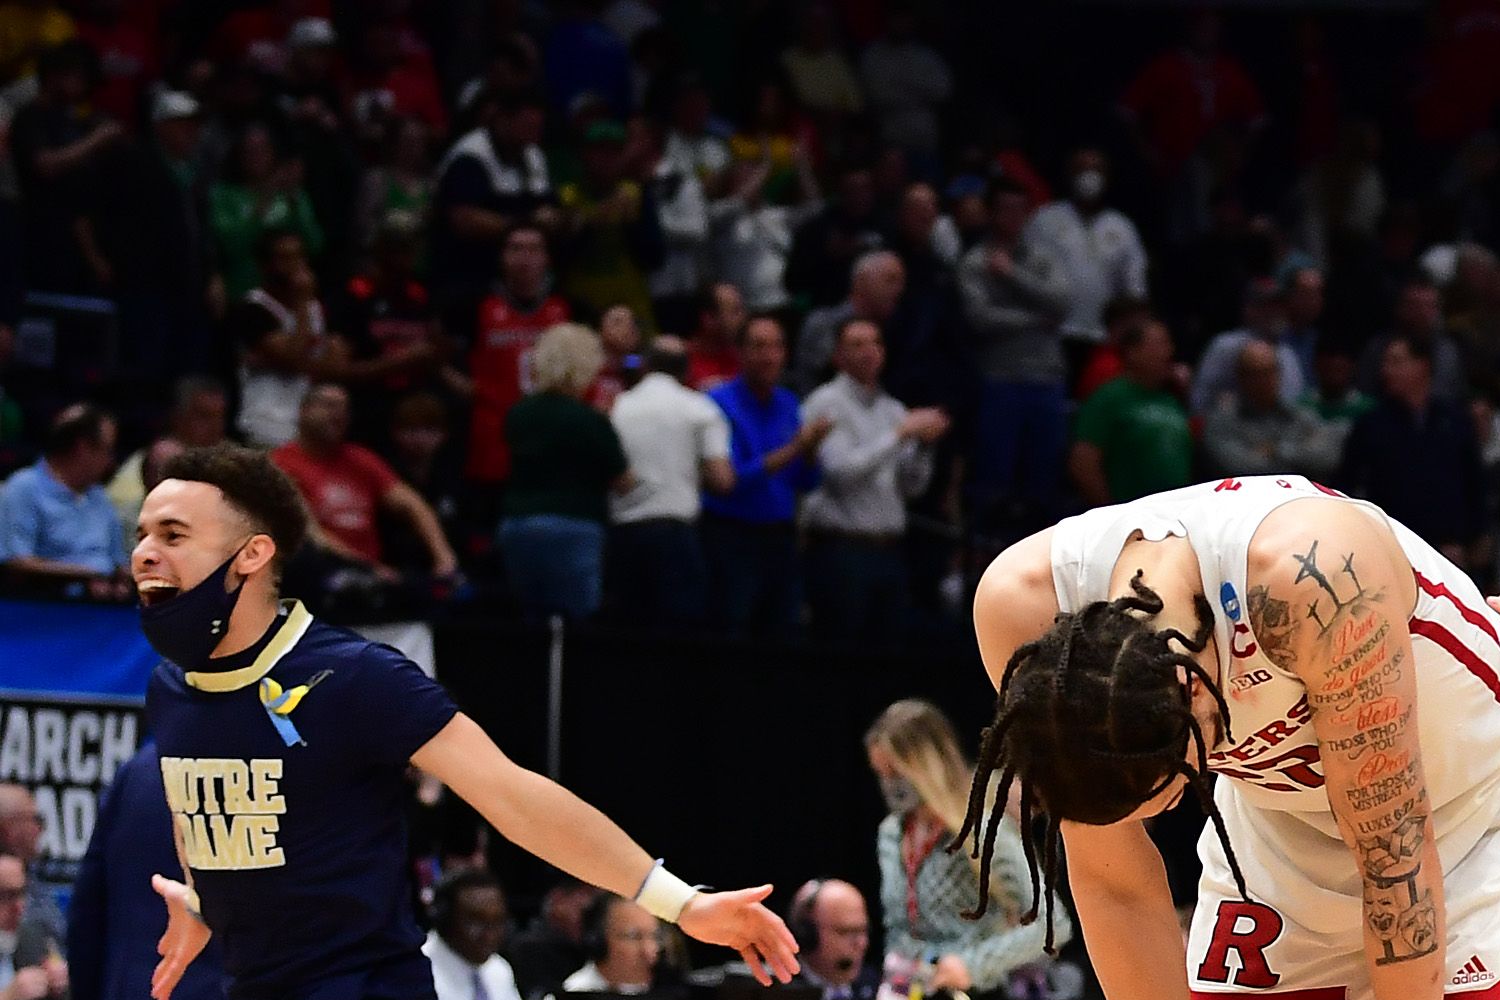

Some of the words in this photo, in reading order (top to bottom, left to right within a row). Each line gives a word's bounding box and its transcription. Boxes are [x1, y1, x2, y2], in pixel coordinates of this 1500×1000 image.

[1359, 684, 1383, 703] YOU
[0, 705, 137, 786] ARCH
[1327, 733, 1367, 752] THOSE
[1367, 722, 1398, 741] WHO
[1370, 738, 1395, 753] YOU
[1346, 785, 1370, 801] FOR
[1358, 812, 1393, 834] LUKE
[1196, 899, 1284, 989] R
[1452, 971, 1495, 985] adidas
